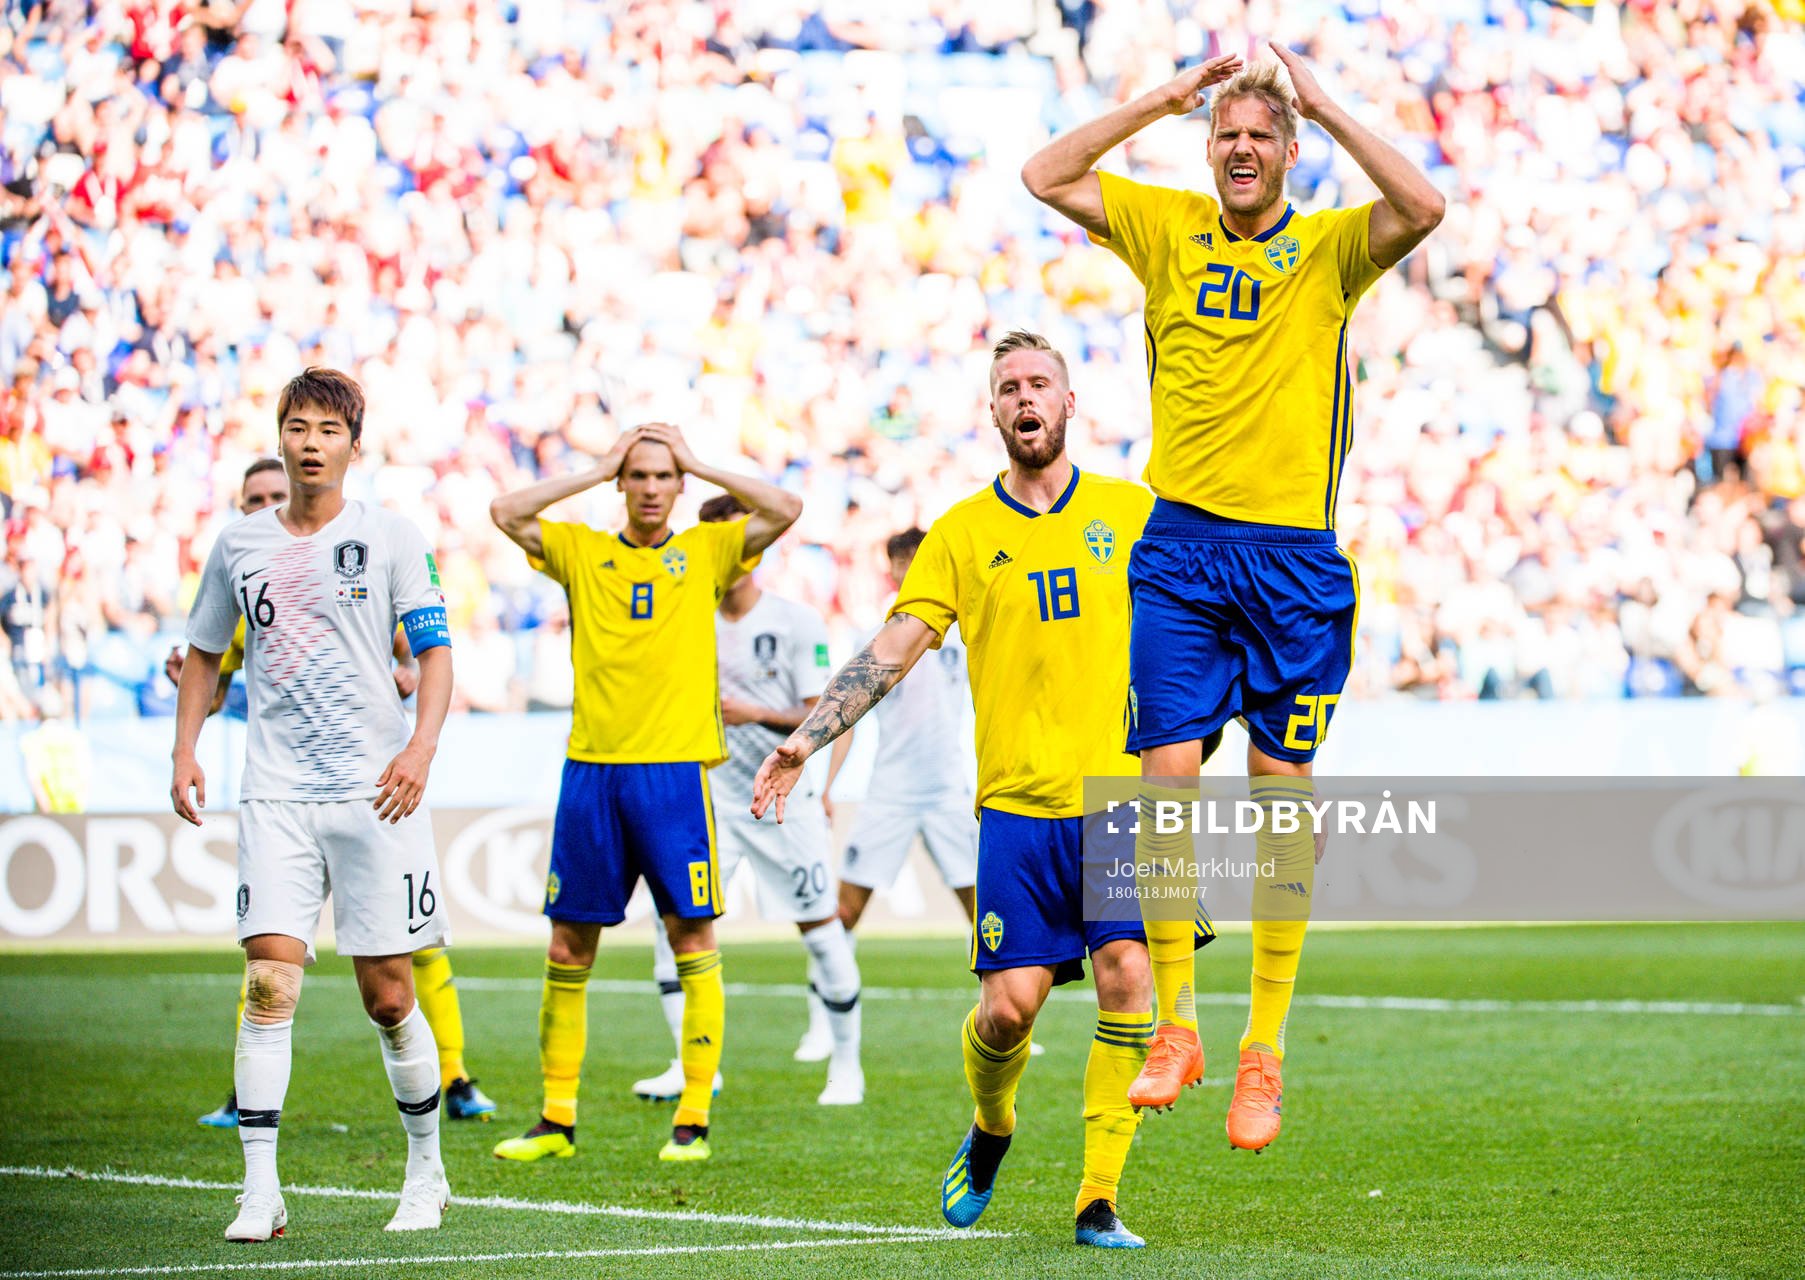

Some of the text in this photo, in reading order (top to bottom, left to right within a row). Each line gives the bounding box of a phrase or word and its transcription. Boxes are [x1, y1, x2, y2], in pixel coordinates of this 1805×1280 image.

[1195, 262, 1263, 321] 20
[988, 557, 1013, 569] adidas
[240, 582, 275, 631] 16
[631, 583, 653, 619] 8
[1027, 567, 1080, 622] 18
[403, 870, 436, 920] 16
[688, 861, 710, 907] 8
[791, 861, 827, 898] 20
